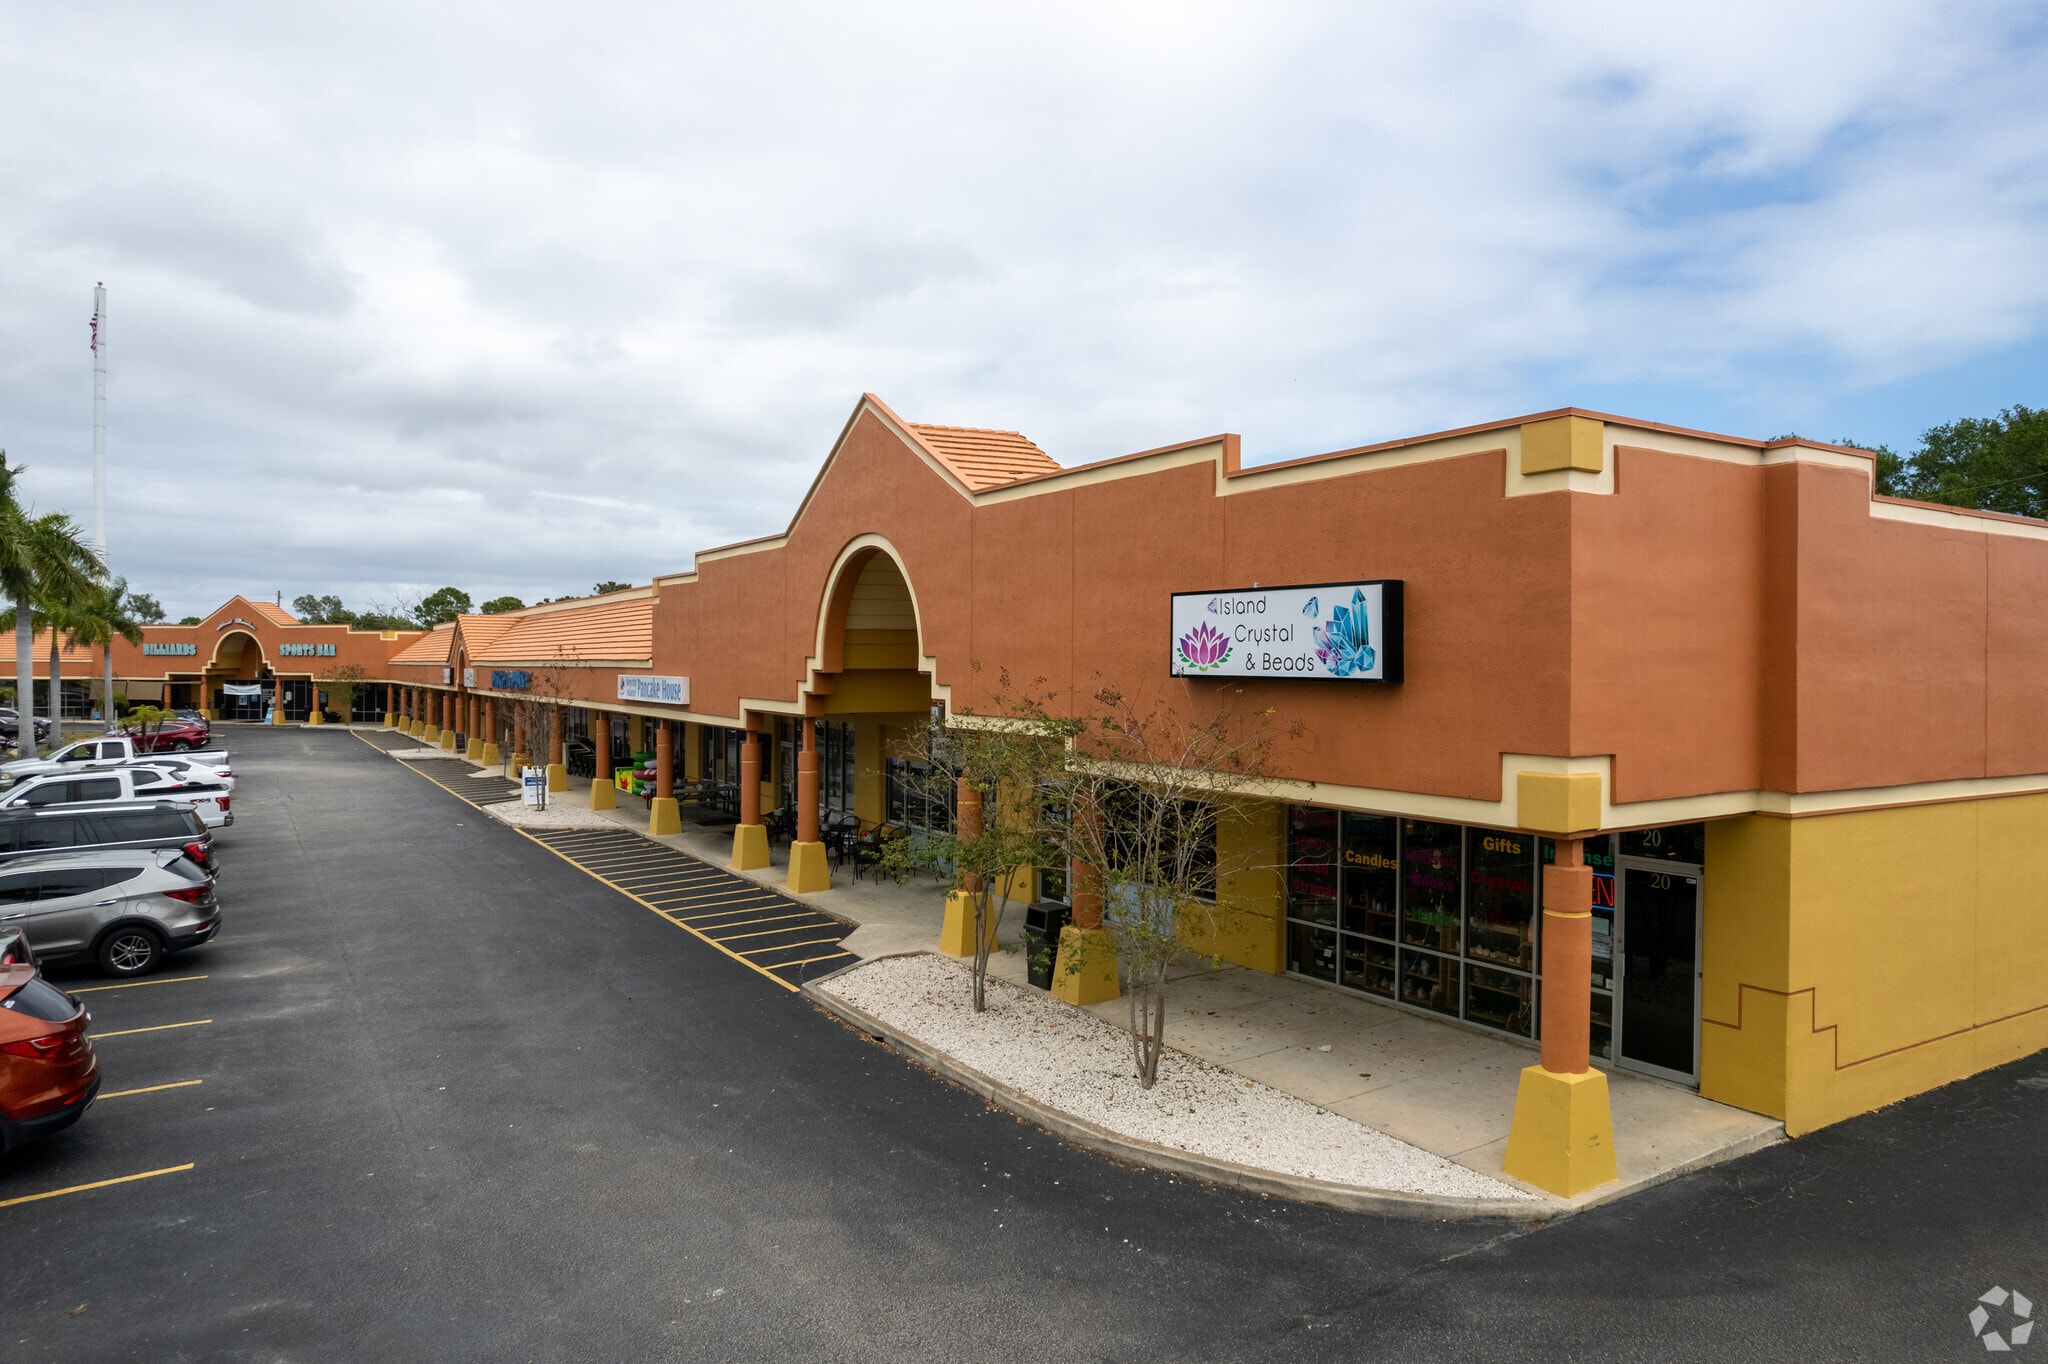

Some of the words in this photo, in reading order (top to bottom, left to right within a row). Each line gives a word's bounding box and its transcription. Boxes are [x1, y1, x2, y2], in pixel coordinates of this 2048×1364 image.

[1219, 596, 1267, 615] Island
[1234, 623, 1294, 646] Crystal
[143, 643, 197, 656] BILLIARDS
[279, 643, 315, 656] SPORTS
[317, 643, 336, 657] BAR
[1245, 653, 1256, 671] &
[1262, 652, 1315, 671] Beads
[637, 677, 660, 699] Pancake
[662, 679, 681, 701] House
[1483, 836, 1521, 855] Gifts
[1643, 829, 1661, 847] 20
[1345, 849, 1397, 870] Candles
[1411, 871, 1455, 892] Books
[1650, 873, 1671, 890] 20
